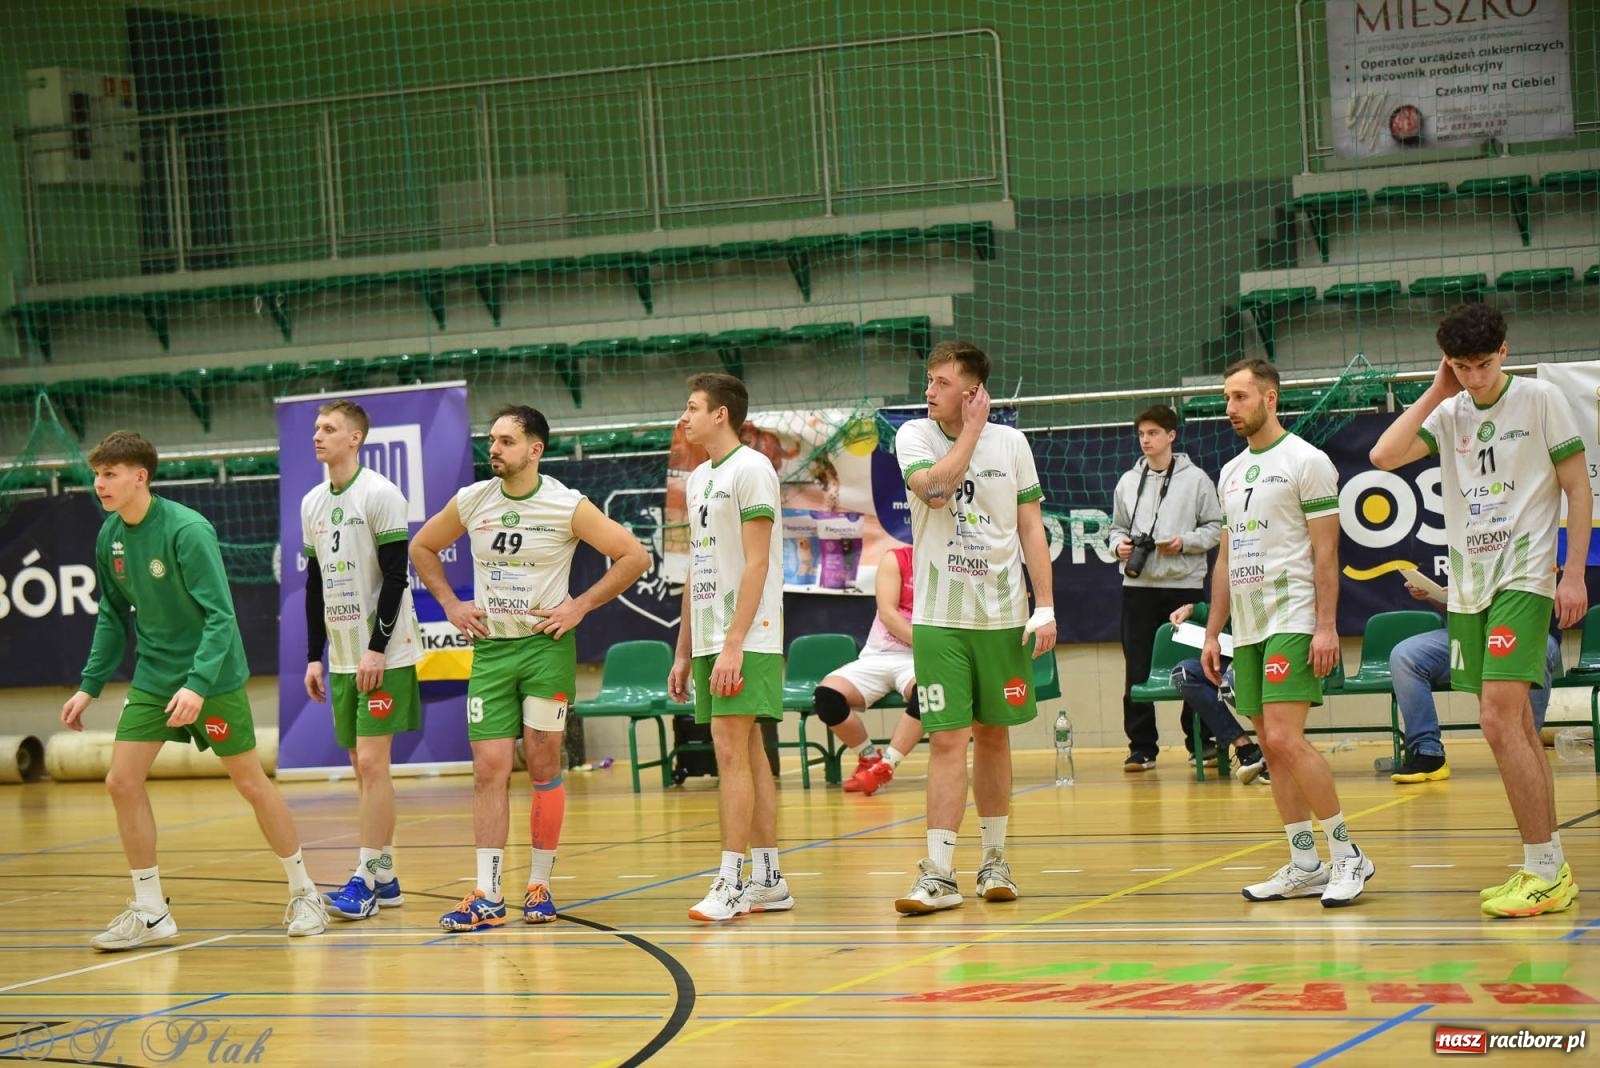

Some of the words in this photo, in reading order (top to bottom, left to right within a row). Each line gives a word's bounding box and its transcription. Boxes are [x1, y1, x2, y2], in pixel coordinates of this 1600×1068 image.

[1355, 0, 1537, 34] MIESZKO
[1361, 55, 1416, 70] Operator
[1419, 49, 1476, 64] urządzeń
[1478, 39, 1564, 56] cukierniczych
[1362, 68, 1426, 84] Pracownik
[1429, 60, 1504, 77] produkcyjny
[1435, 83, 1489, 97] Czekamy
[1492, 81, 1507, 90] na
[1511, 76, 1556, 89] Ciebie!
[1477, 446, 1496, 476] 11
[1243, 487, 1254, 513] 7
[1460, 480, 1515, 498] VISON
[949, 507, 991, 525] VSON
[331, 530, 341, 553] 3
[490, 532, 523, 555] 49
[1466, 529, 1512, 547] PIVEXIN
[0, 549, 100, 619] ÓR
[326, 603, 361, 615] PIVEXIN
[488, 597, 529, 609] PIVEXIN
[466, 696, 484, 724] 9
